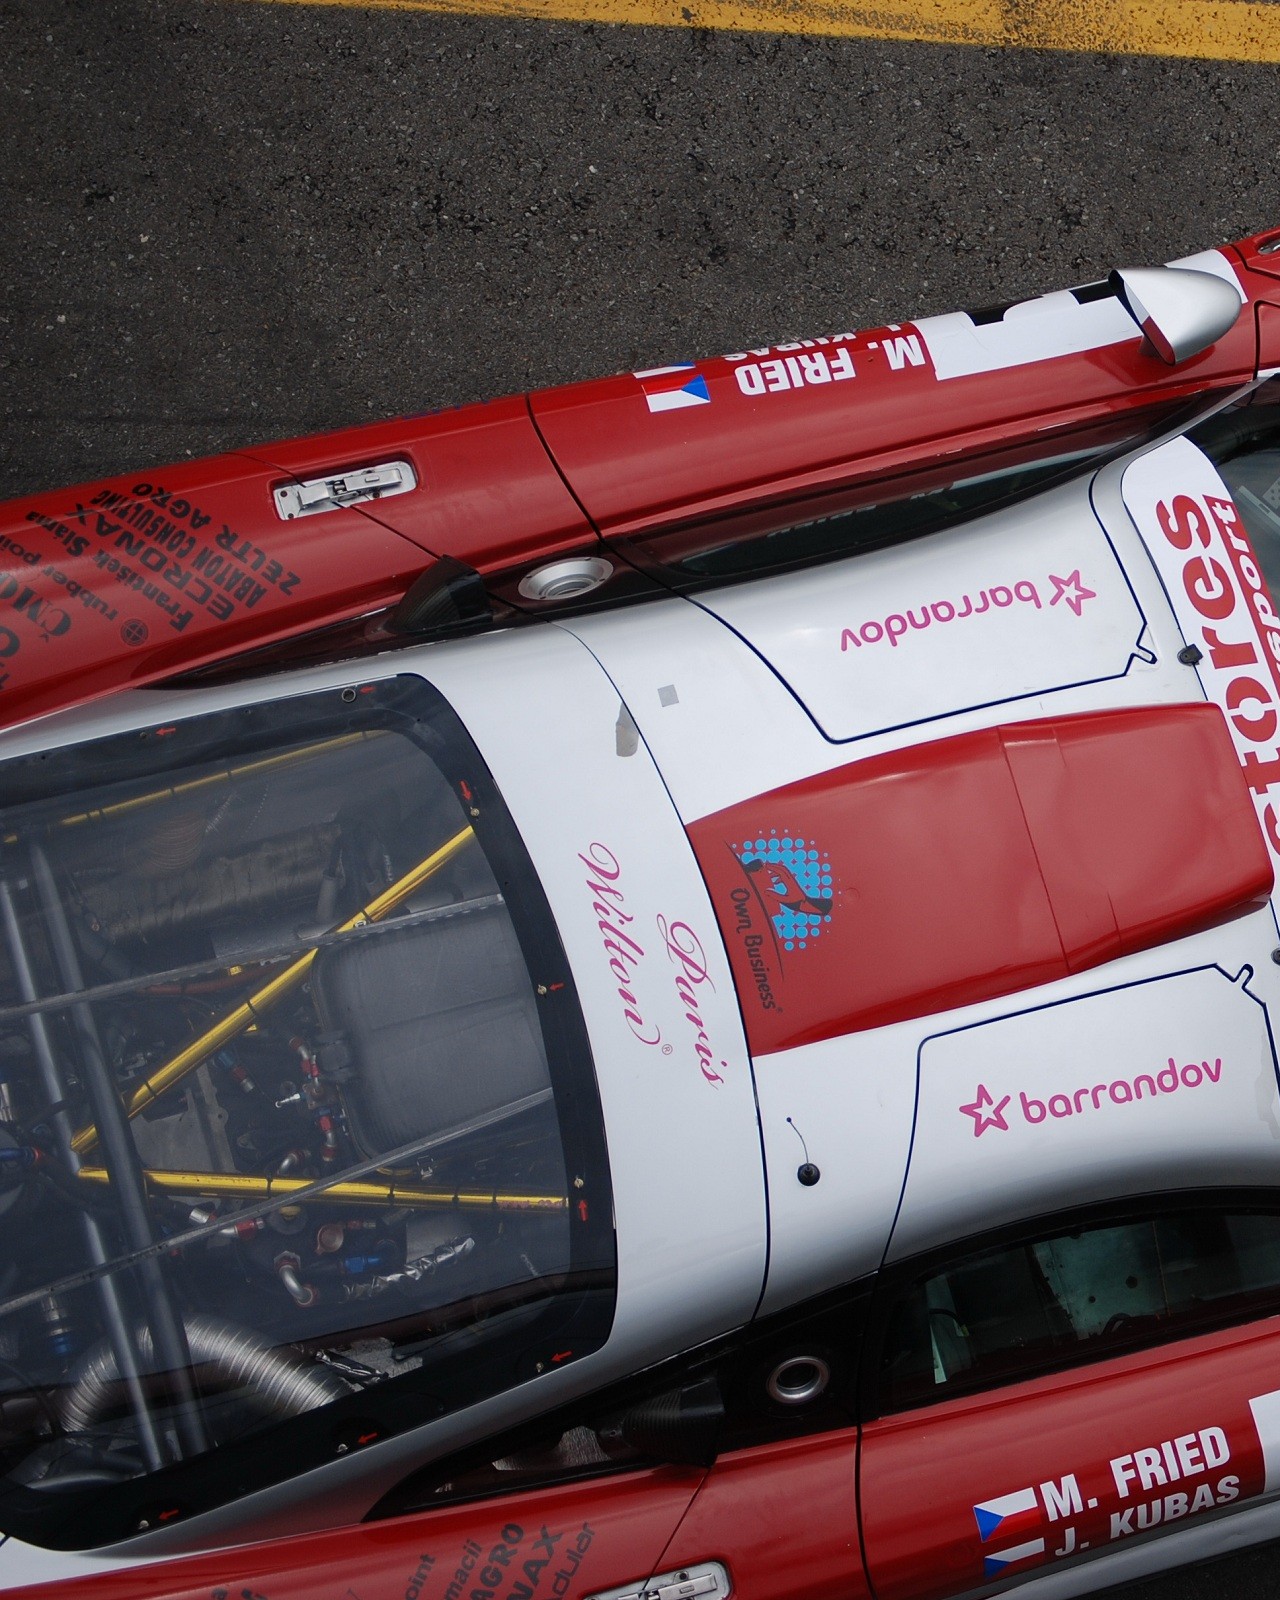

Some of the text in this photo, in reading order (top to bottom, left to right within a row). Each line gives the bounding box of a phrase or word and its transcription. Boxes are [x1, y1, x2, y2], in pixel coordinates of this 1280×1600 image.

[735, 347, 856, 396] FRIED
[867, 334, 926, 370] M.
[0, 534, 119, 622] rubber poi
[25, 511, 195, 632] František Sláma
[65, 503, 235, 622] ECRONAX
[90, 489, 267, 608] ABATON CONSULTING
[132, 483, 301, 596] ZELTR AGRO
[0, 571, 72, 643] ČMO
[840, 580, 1042, 652] barrandov
[577, 842, 661, 1046] Wilton
[730, 886, 777, 1011] Own Business
[656, 912, 728, 1091] Paris
[1019, 1057, 1223, 1125] barrandov
[1039, 1425, 1231, 1522] M. FRIED
[1055, 1475, 1240, 1557] J. KUBAS
[404, 1553, 437, 1600] oint
[443, 1538, 484, 1600] macii
